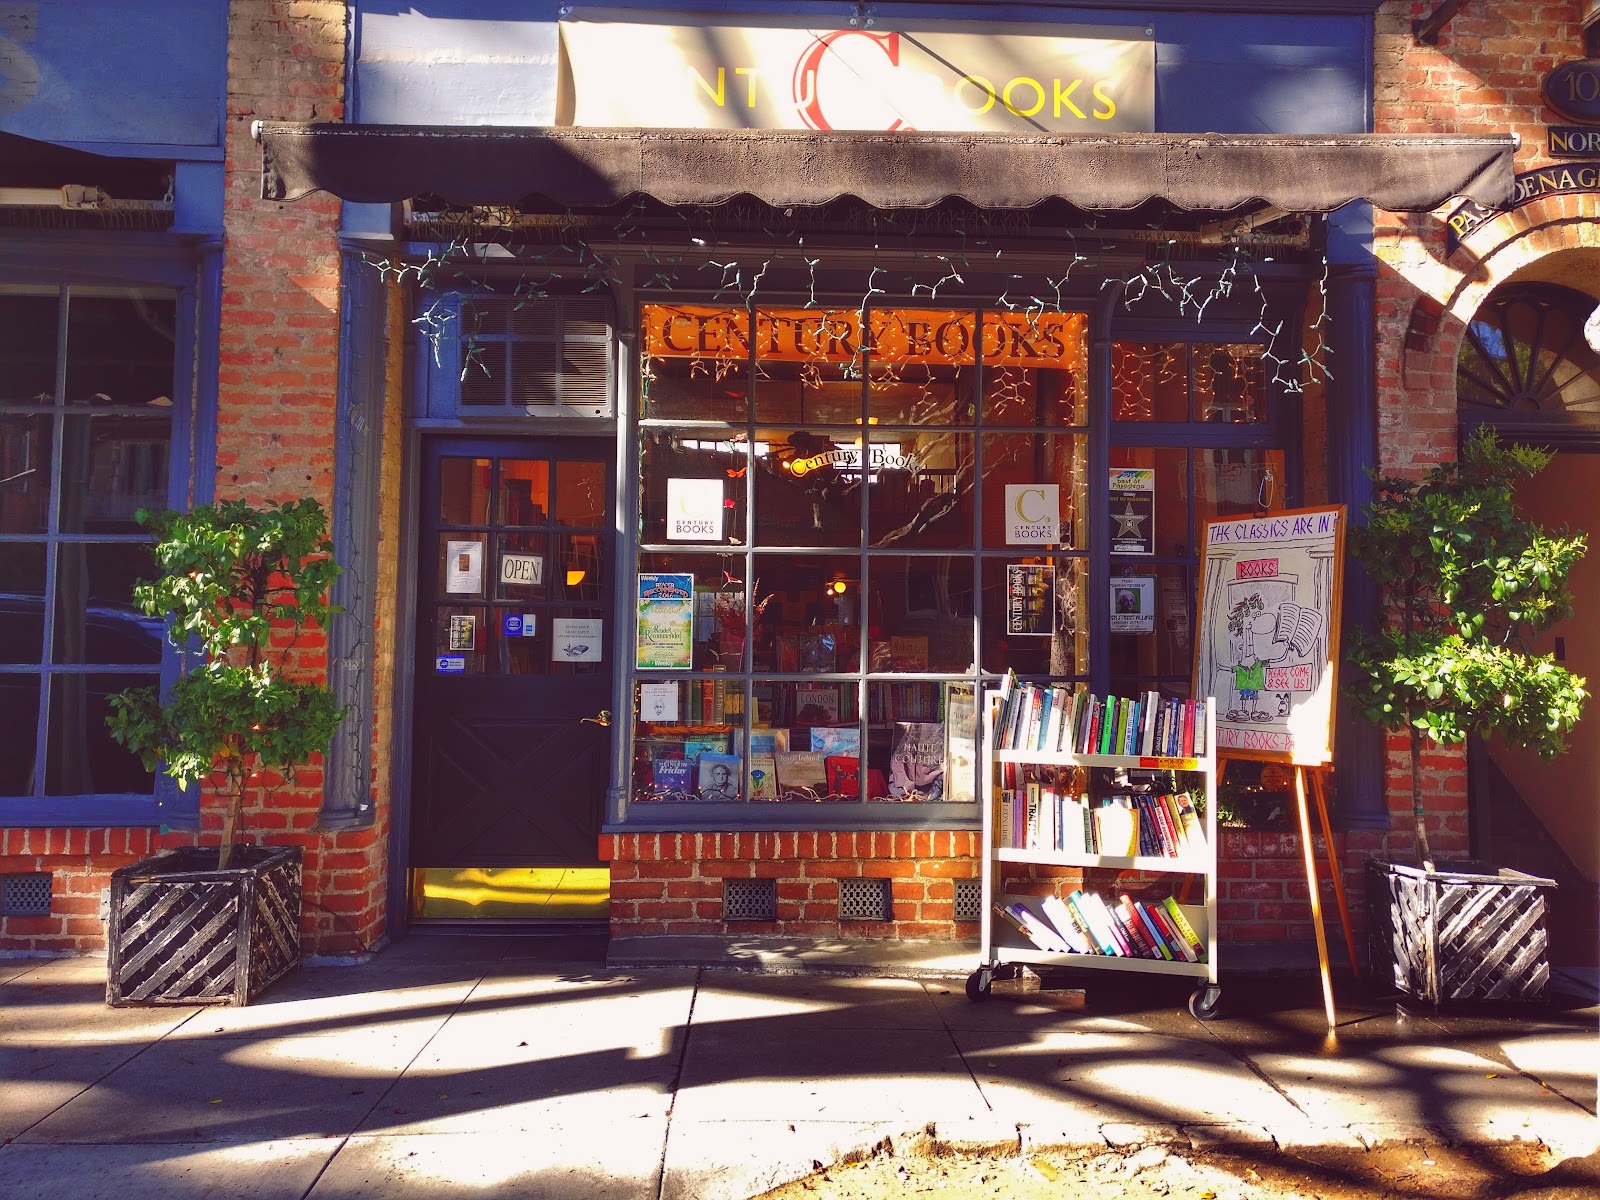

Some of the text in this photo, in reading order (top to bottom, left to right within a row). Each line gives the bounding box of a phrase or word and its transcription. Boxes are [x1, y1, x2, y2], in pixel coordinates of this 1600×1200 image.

[1562, 72, 1600, 101] 10
[953, 75, 1117, 120] OOKS
[1449, 169, 1578, 236] PASDENA
[663, 316, 1065, 360] CENTURY BOOKS
[790, 449, 858, 474] Century
[676, 525, 714, 533] BOOKS
[1015, 530, 1052, 538] BOOKS
[1210, 525, 1230, 542] THE
[1235, 519, 1288, 539] CLASSICS
[1292, 517, 1313, 535] ARE
[504, 559, 540, 582] OPEN
[1240, 562, 1275, 577] BOOKS
[1012, 569, 1023, 631] CENTURY BOOKS
[645, 629, 682, 642] Recommended
[1268, 666, 1310, 679] PLEASE COME
[1293, 678, 1309, 689] US!
[800, 693, 835, 704] LONDON
[1216, 728, 1240, 747] TURY
[1244, 731, 1279, 750] BOOKS
[903, 743, 936, 753] HAUTE
[798, 754, 820, 762] Ireland
[659, 766, 688, 775] Friday
